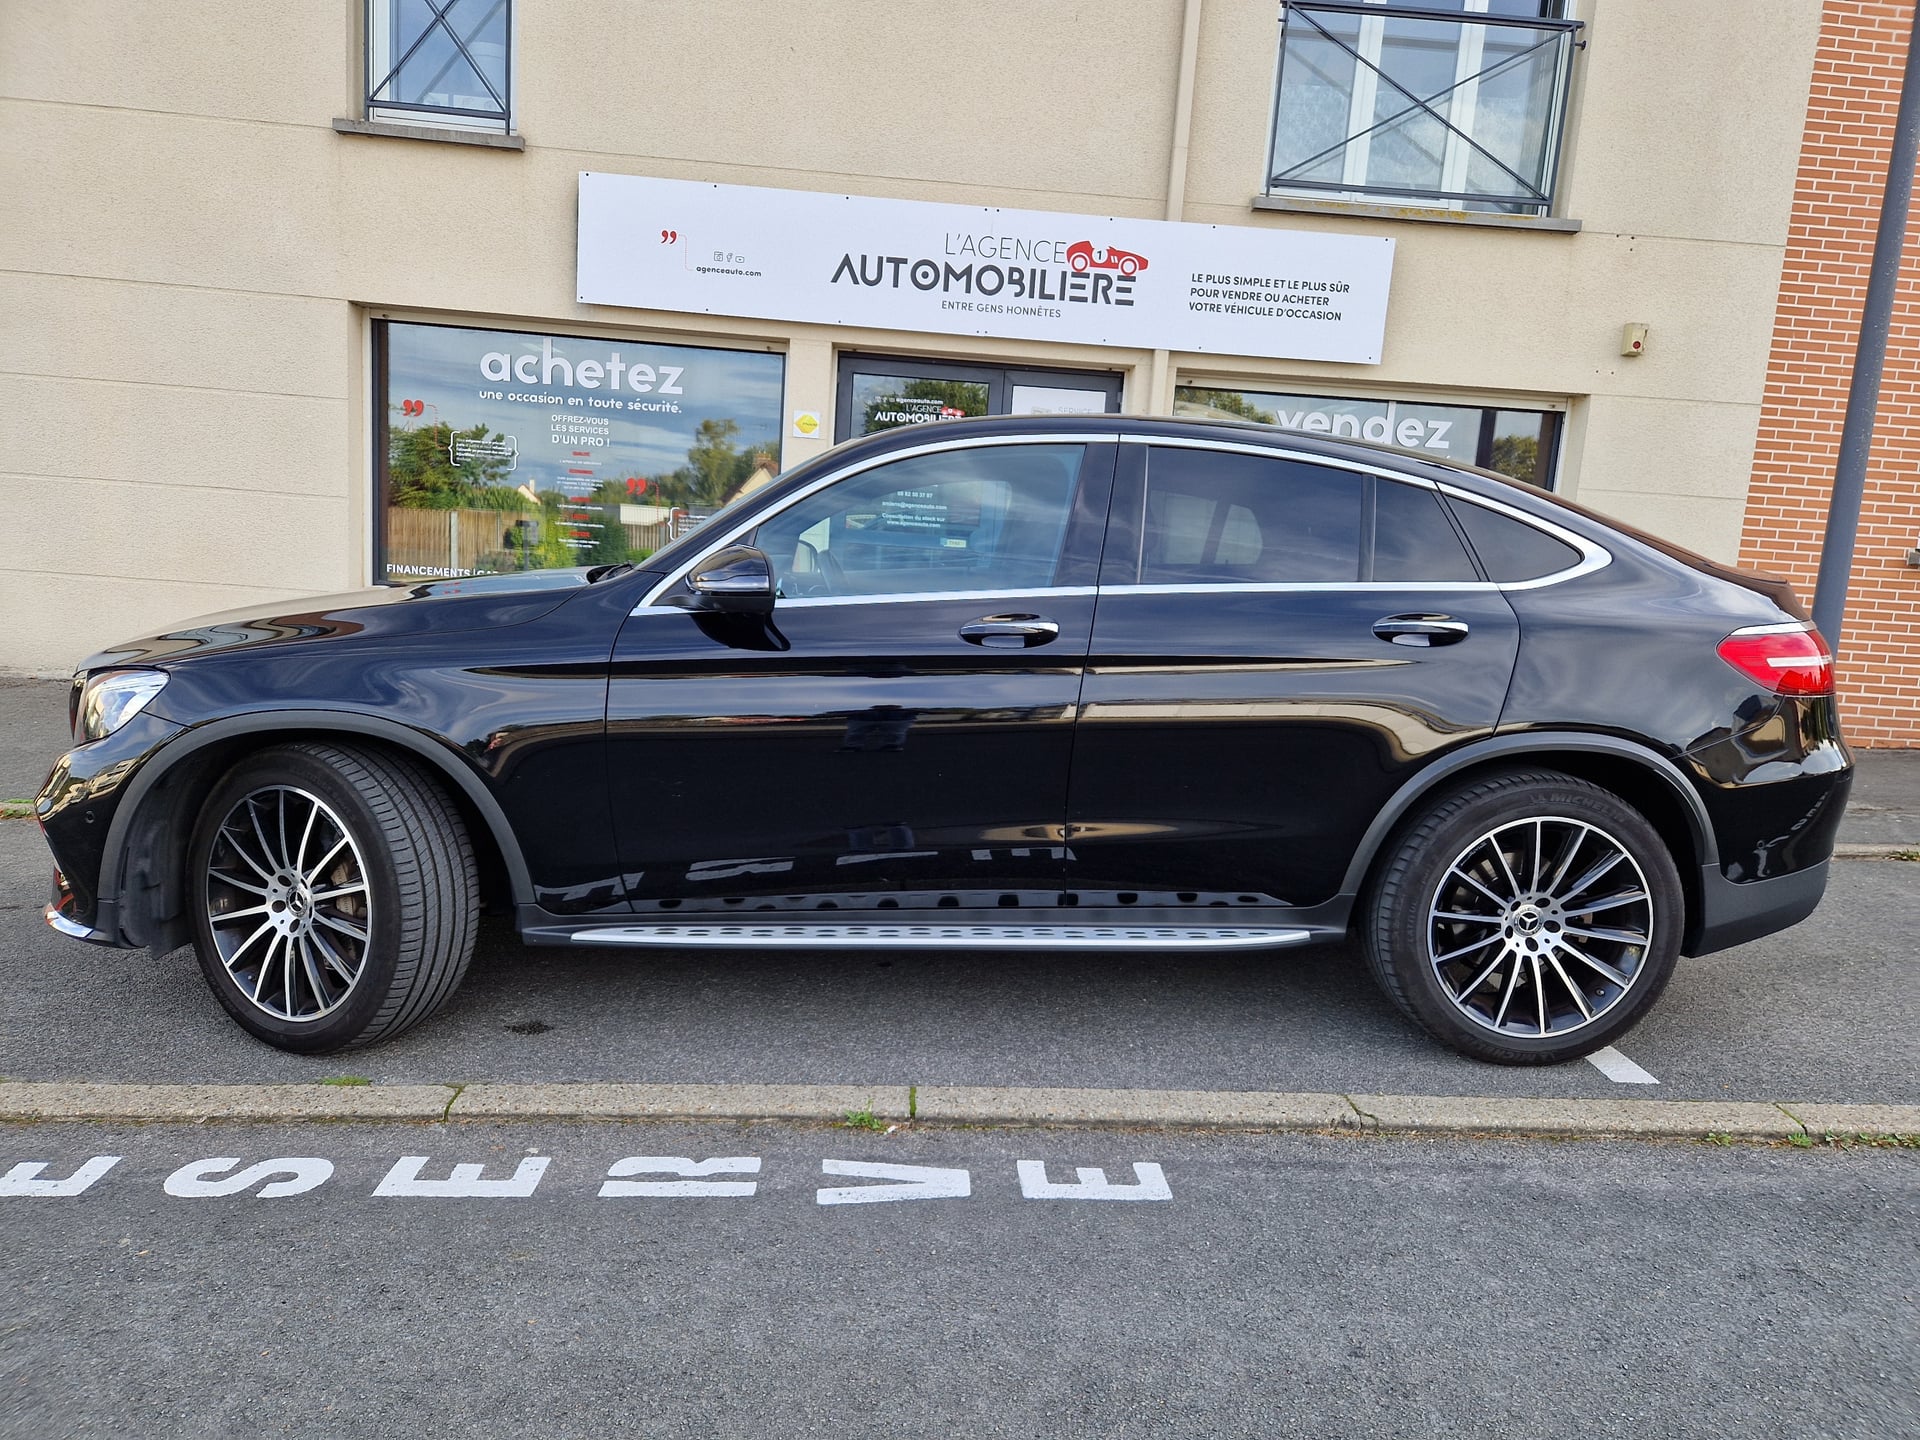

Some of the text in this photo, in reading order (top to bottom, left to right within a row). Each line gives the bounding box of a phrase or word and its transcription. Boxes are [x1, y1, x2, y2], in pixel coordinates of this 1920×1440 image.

[945, 232, 1067, 264] L'AGENCE
[1096, 250, 1102, 260] 1
[696, 266, 762, 277] agenceauto.com
[1191, 273, 1350, 294] LE PLUS SIMPLE ET LE PLUS SÛR
[1190, 287, 1330, 307] POUR VENDRE OU ACHETER
[941, 300, 1061, 318] ENTRE GENS HONNÊTES
[1189, 301, 1342, 321] VOTRE VÉHICULE D'OCCASION
[480, 337, 685, 395] achetez
[479, 390, 682, 414] une occasion en toute sécurité.
[906, 405, 941, 414] L'AGENCE
[551, 414, 609, 426] OFFREZ-VOUS
[1277, 401, 1453, 449] vendez
[551, 424, 609, 435] LES SERVICES
[551, 434, 578, 445] D'UN
[580, 437, 604, 447] PRO
[386, 563, 471, 577] FINANCEMENTS
